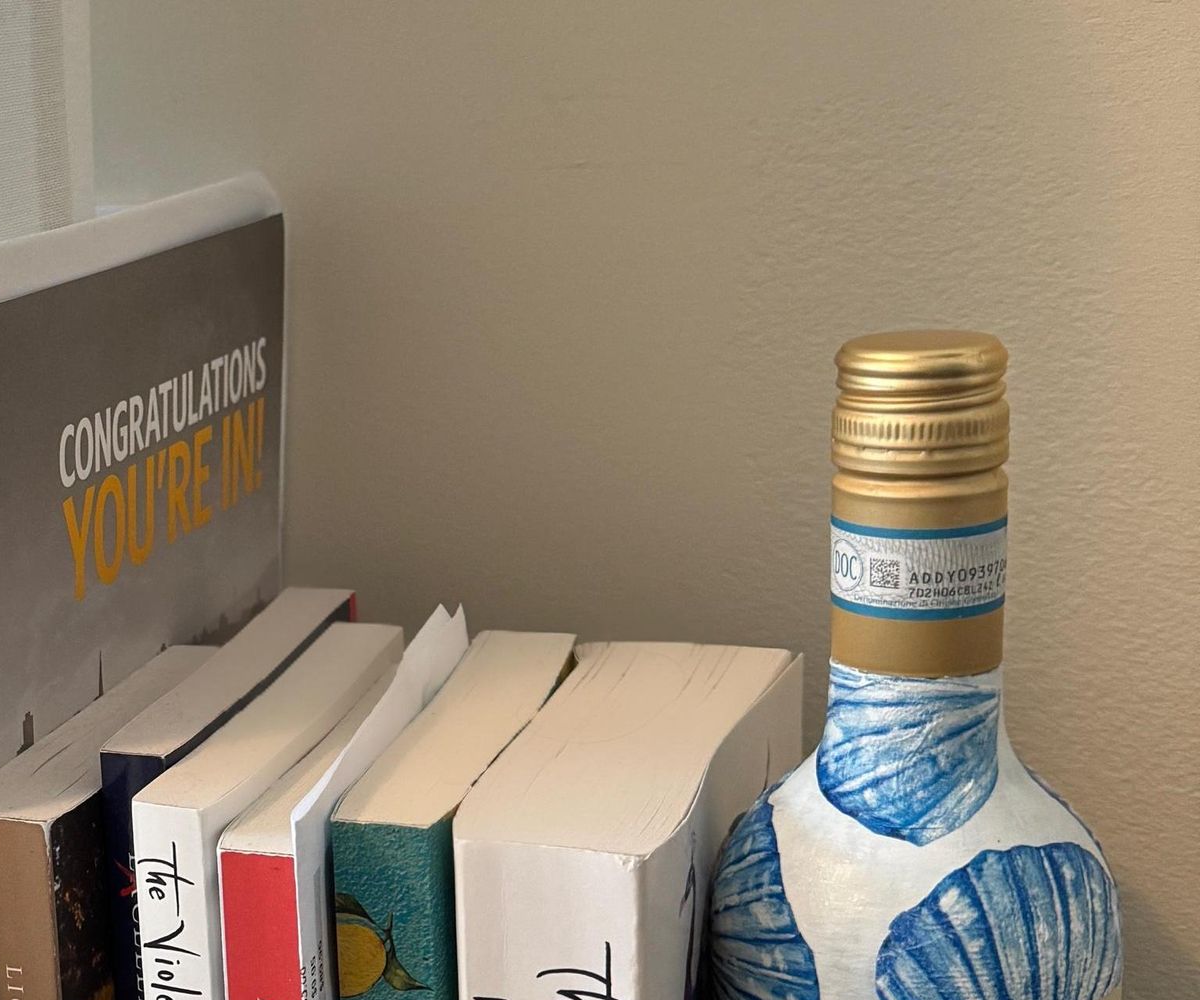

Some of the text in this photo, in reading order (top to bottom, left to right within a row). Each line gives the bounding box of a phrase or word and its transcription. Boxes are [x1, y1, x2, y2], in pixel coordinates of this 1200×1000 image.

[59, 336, 267, 488] CONGRATULATIONS
[62, 396, 266, 602] YOU'RE IN!
[834, 550, 858, 581] DOC
[137, 840, 195, 918] The
